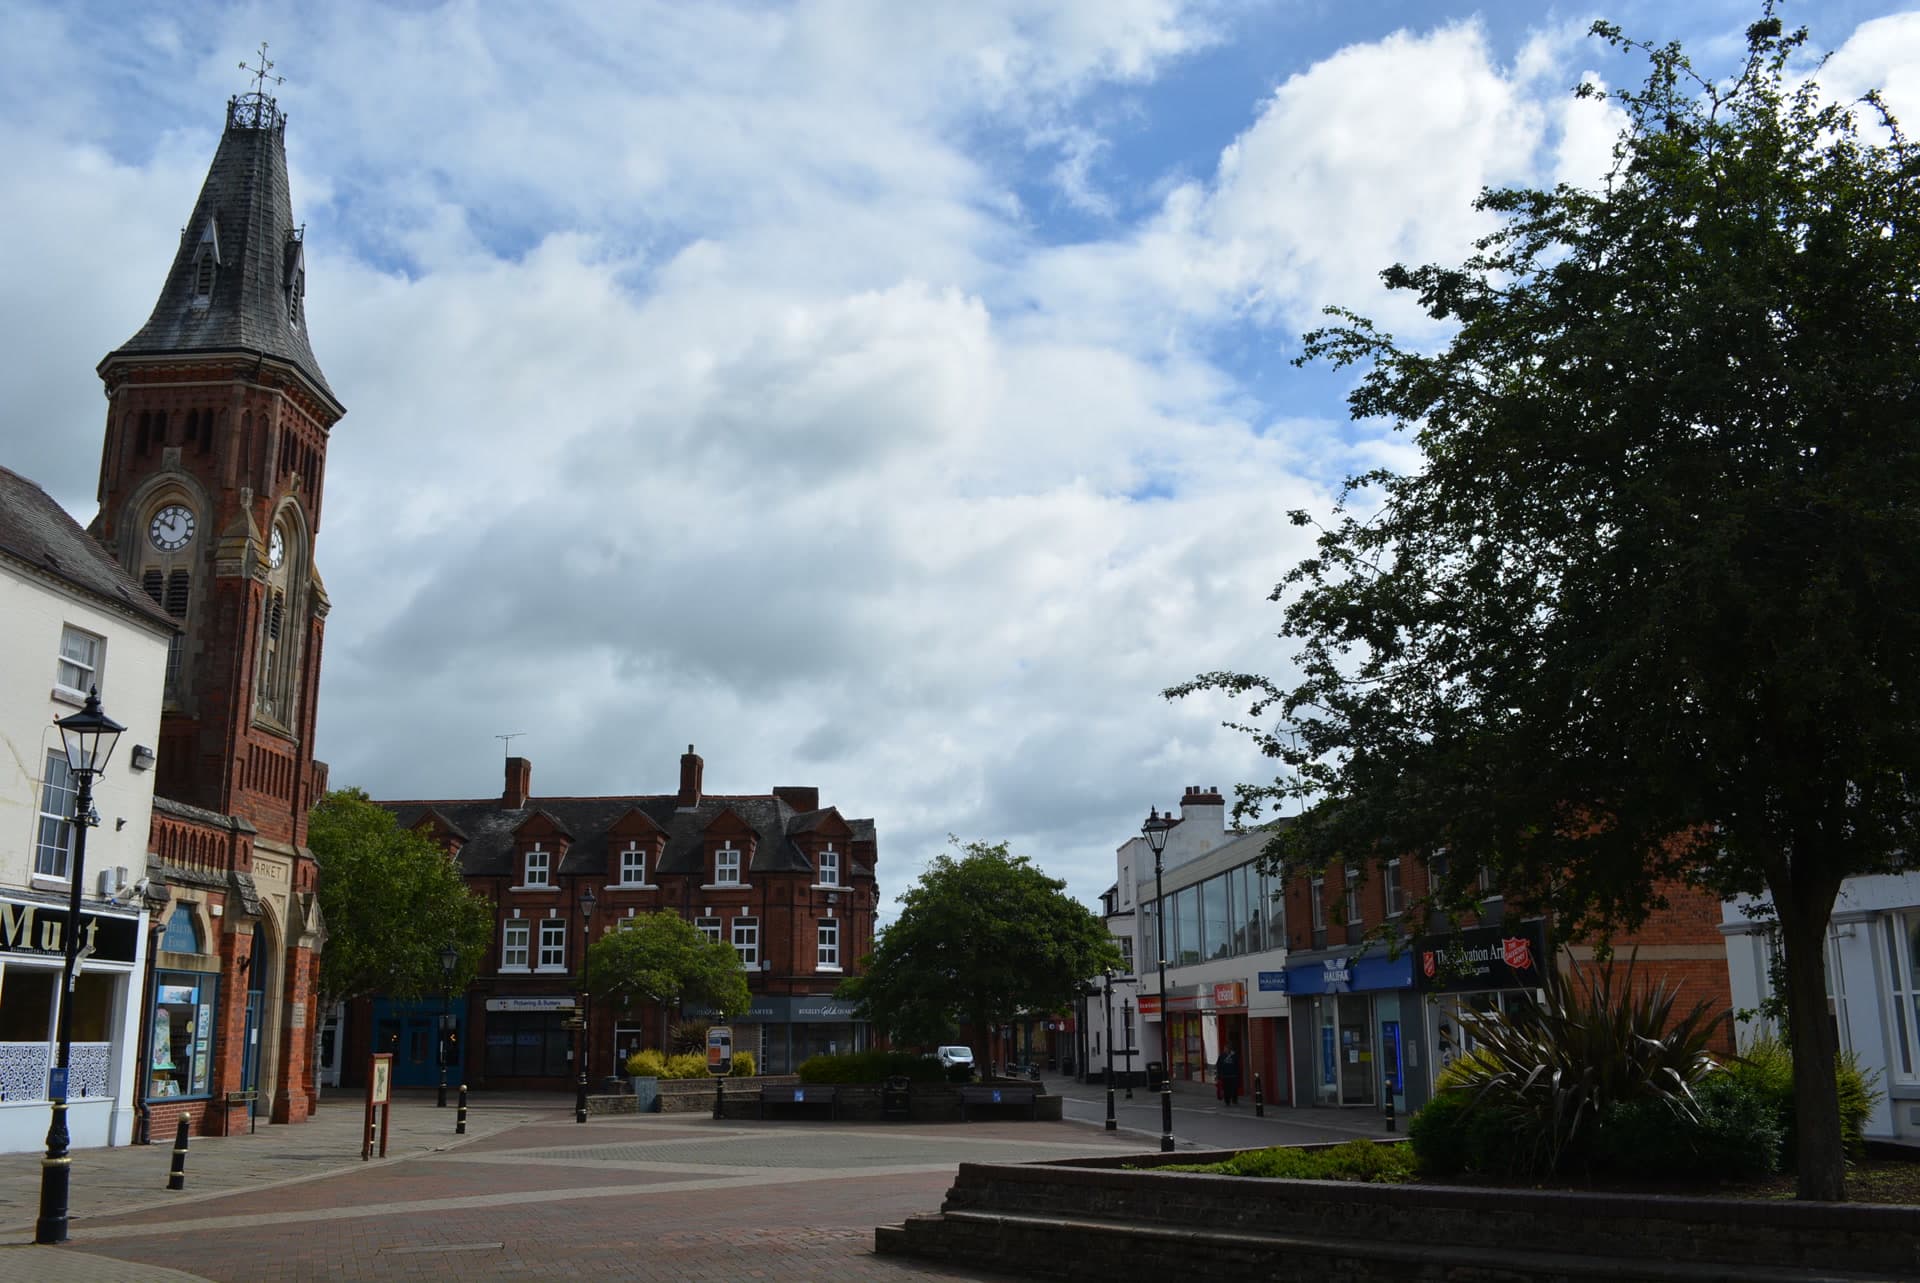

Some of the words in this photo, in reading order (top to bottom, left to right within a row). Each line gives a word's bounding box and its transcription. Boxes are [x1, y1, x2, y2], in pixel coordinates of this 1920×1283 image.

[255, 862, 283, 879] ARKET
[0, 902, 100, 952] Mut
[1452, 945, 1489, 963] lvation
[1323, 969, 1350, 983] HALIFAX
[821, 1006, 837, 1017] Gold
